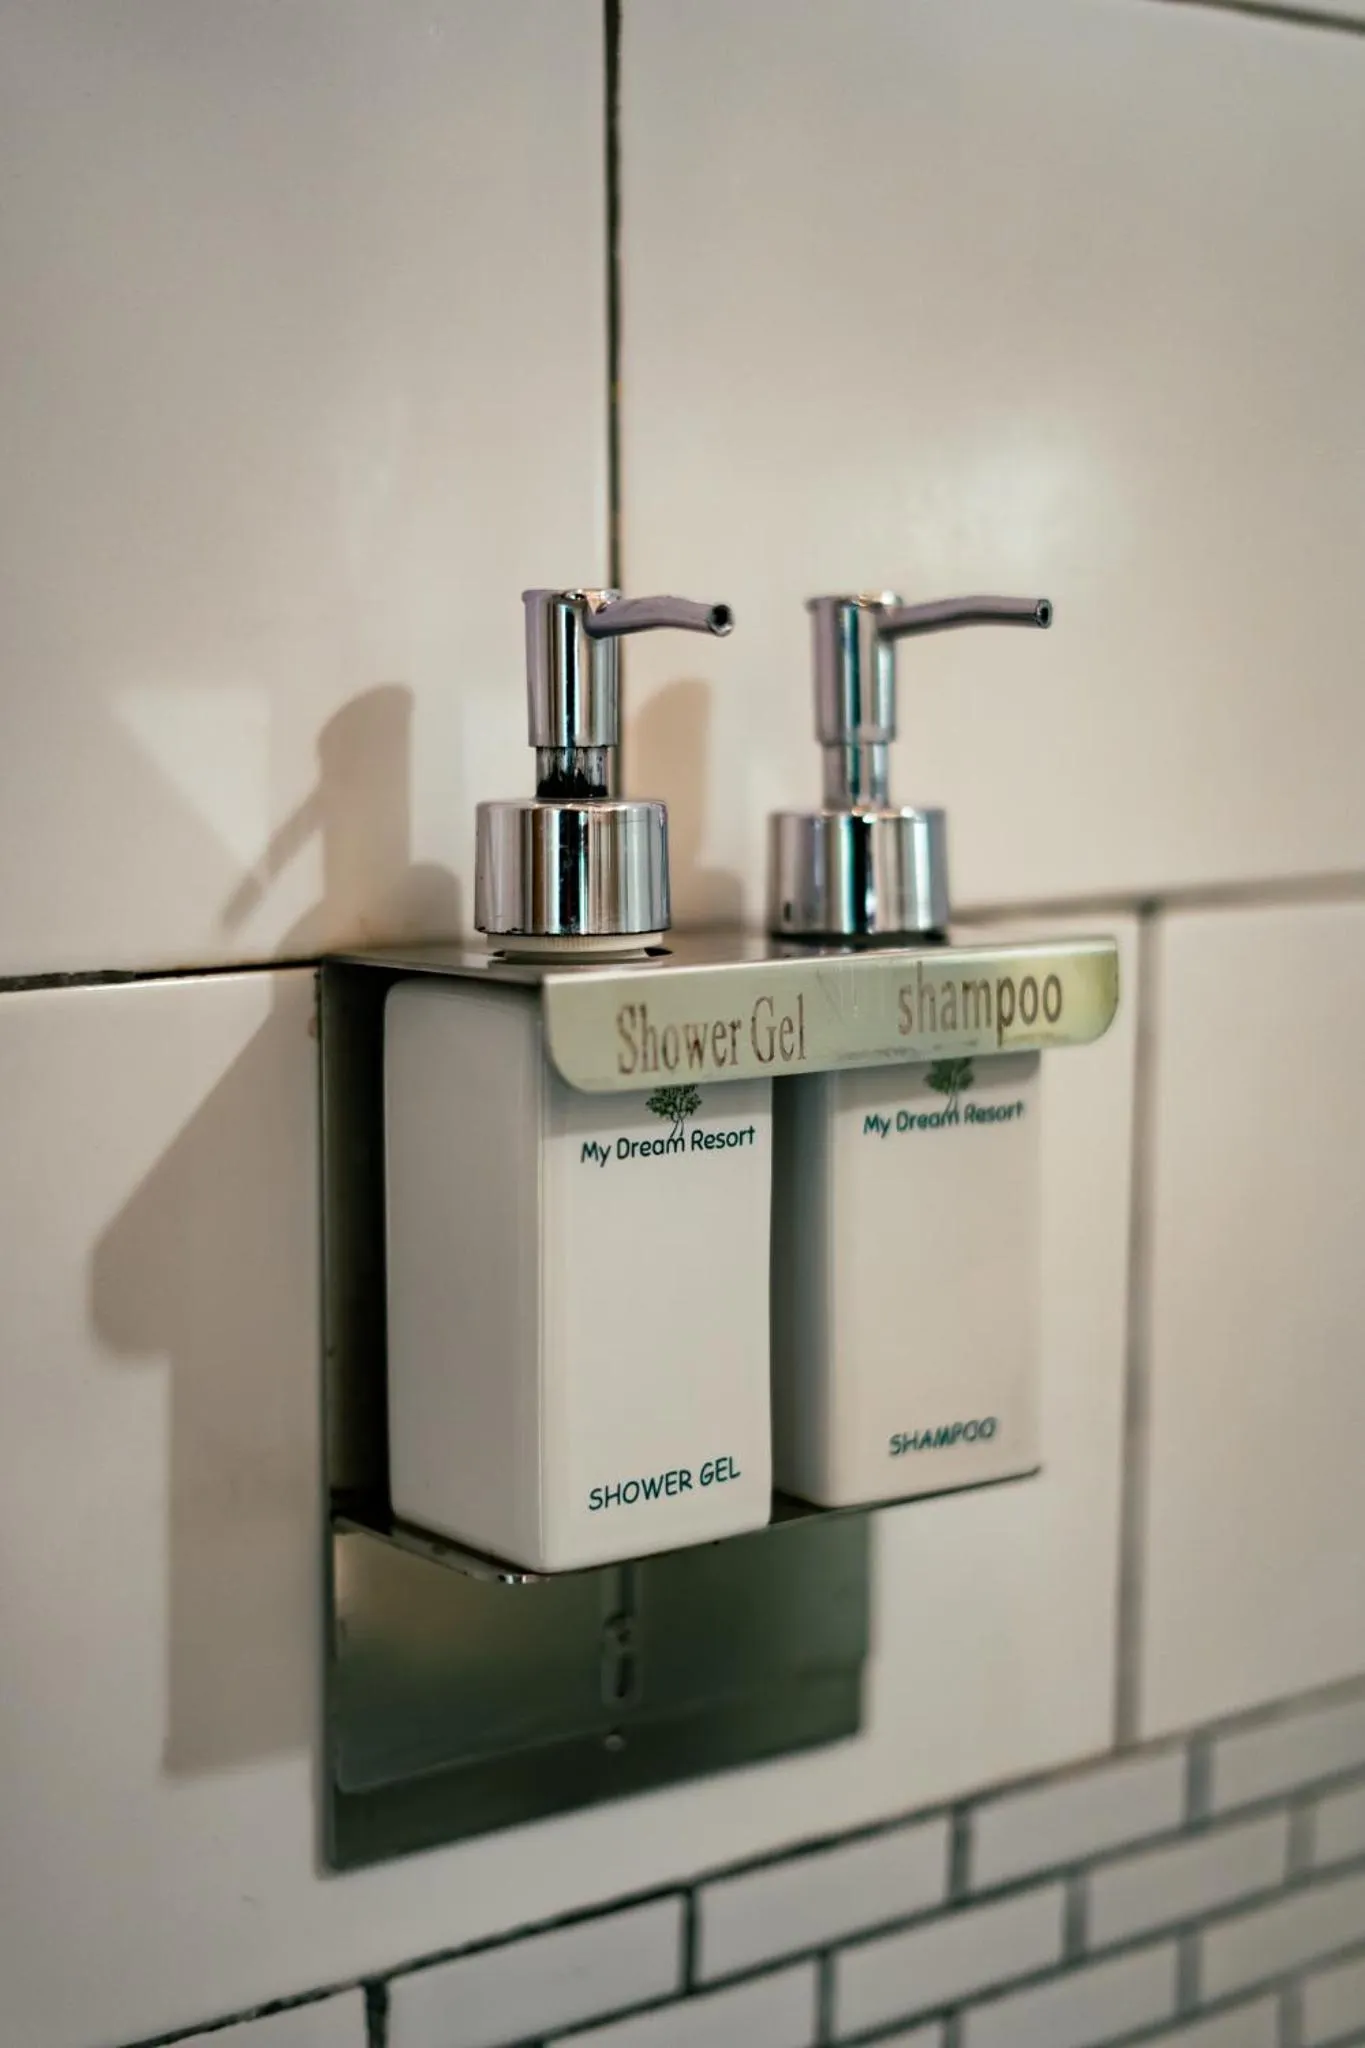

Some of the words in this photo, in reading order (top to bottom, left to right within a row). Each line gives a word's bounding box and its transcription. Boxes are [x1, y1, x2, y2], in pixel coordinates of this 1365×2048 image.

[898, 961, 1063, 1047] shampoo
[616, 1003, 741, 1076] Shower
[751, 993, 806, 1064] Gel
[863, 1113, 890, 1138] My
[896, 1107, 960, 1132] Dream
[964, 1100, 1024, 1125] Resort
[580, 1140, 611, 1167] My
[617, 1136, 686, 1161] Dream
[692, 1125, 755, 1151] Resort
[889, 1417, 998, 1456] SHAMPOO
[589, 1469, 692, 1511] SHOWER
[700, 1456, 741, 1486] GEL
